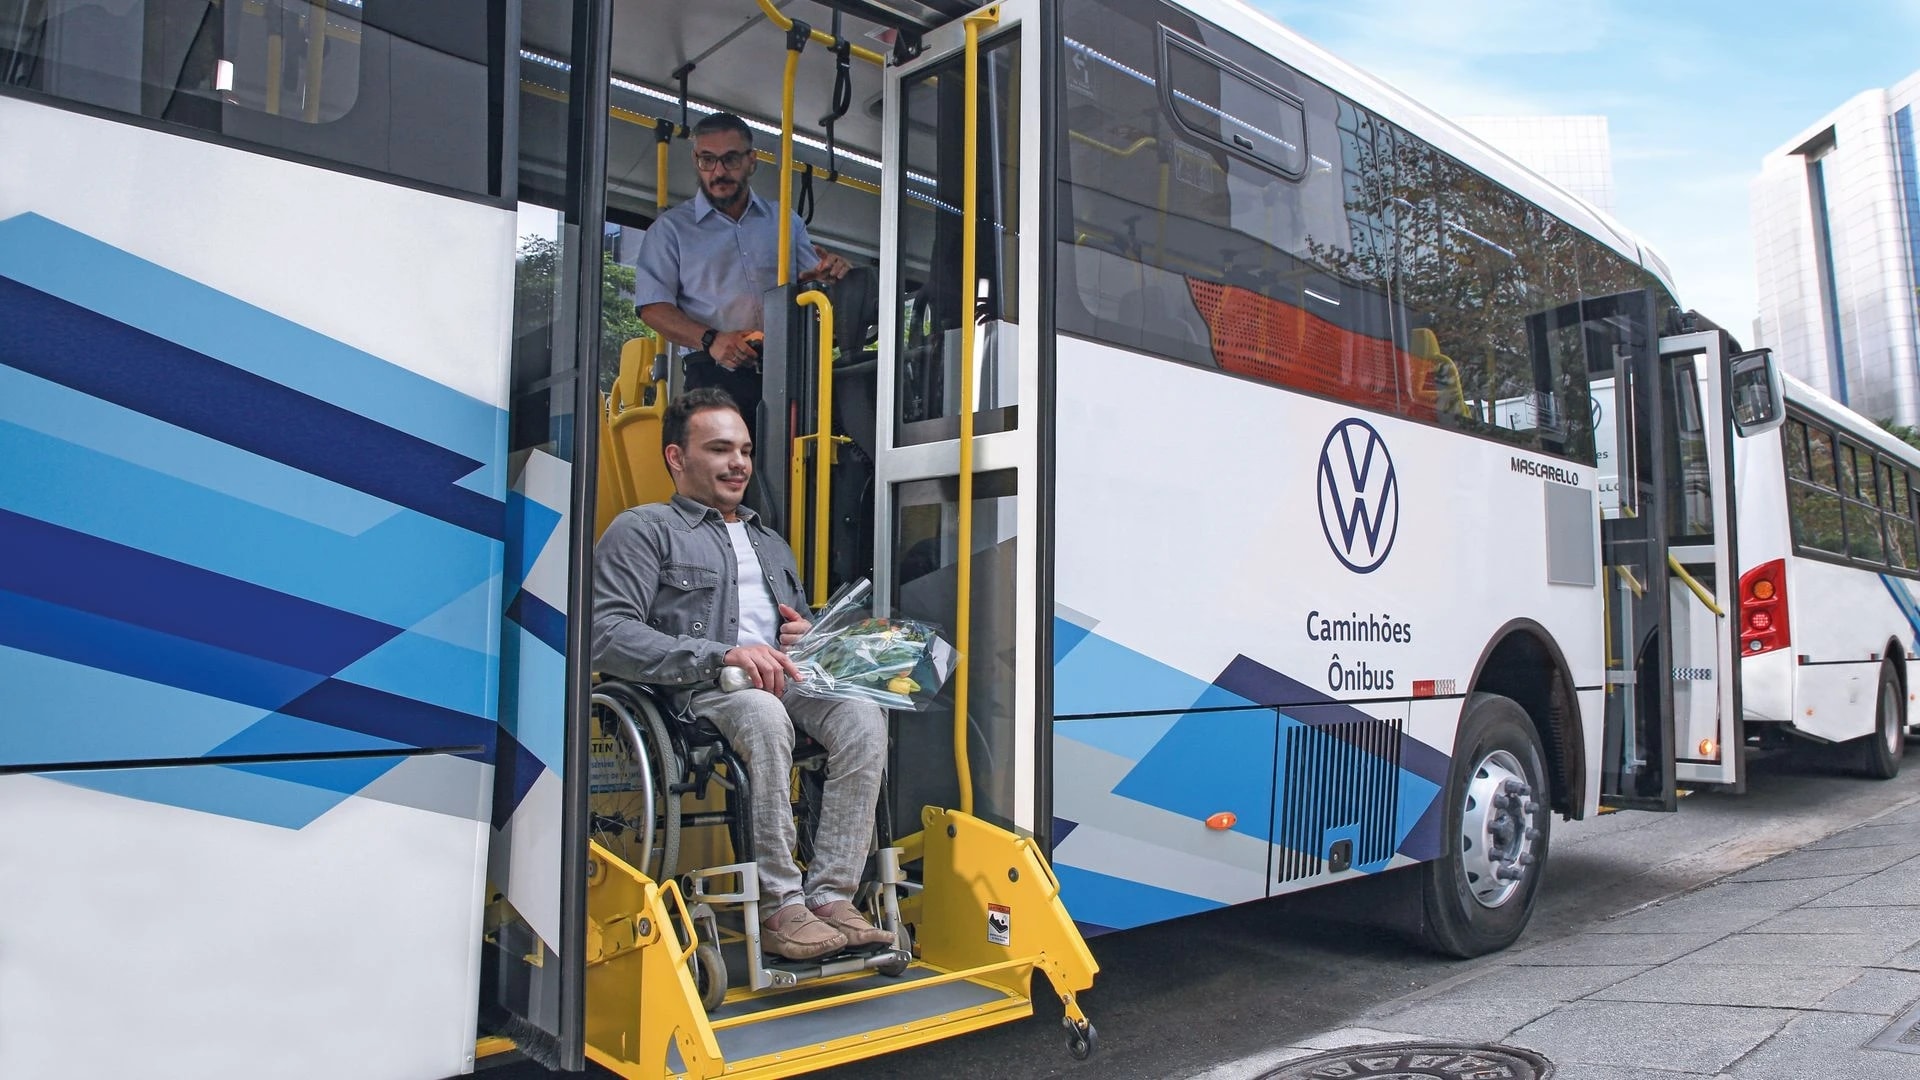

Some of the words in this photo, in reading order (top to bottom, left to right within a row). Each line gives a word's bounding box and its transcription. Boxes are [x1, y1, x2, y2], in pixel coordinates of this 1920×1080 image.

[1511, 457, 1579, 486] MASCARELLO
[1306, 610, 1411, 643] Caminhões
[1328, 653, 1394, 691] Ônibus
